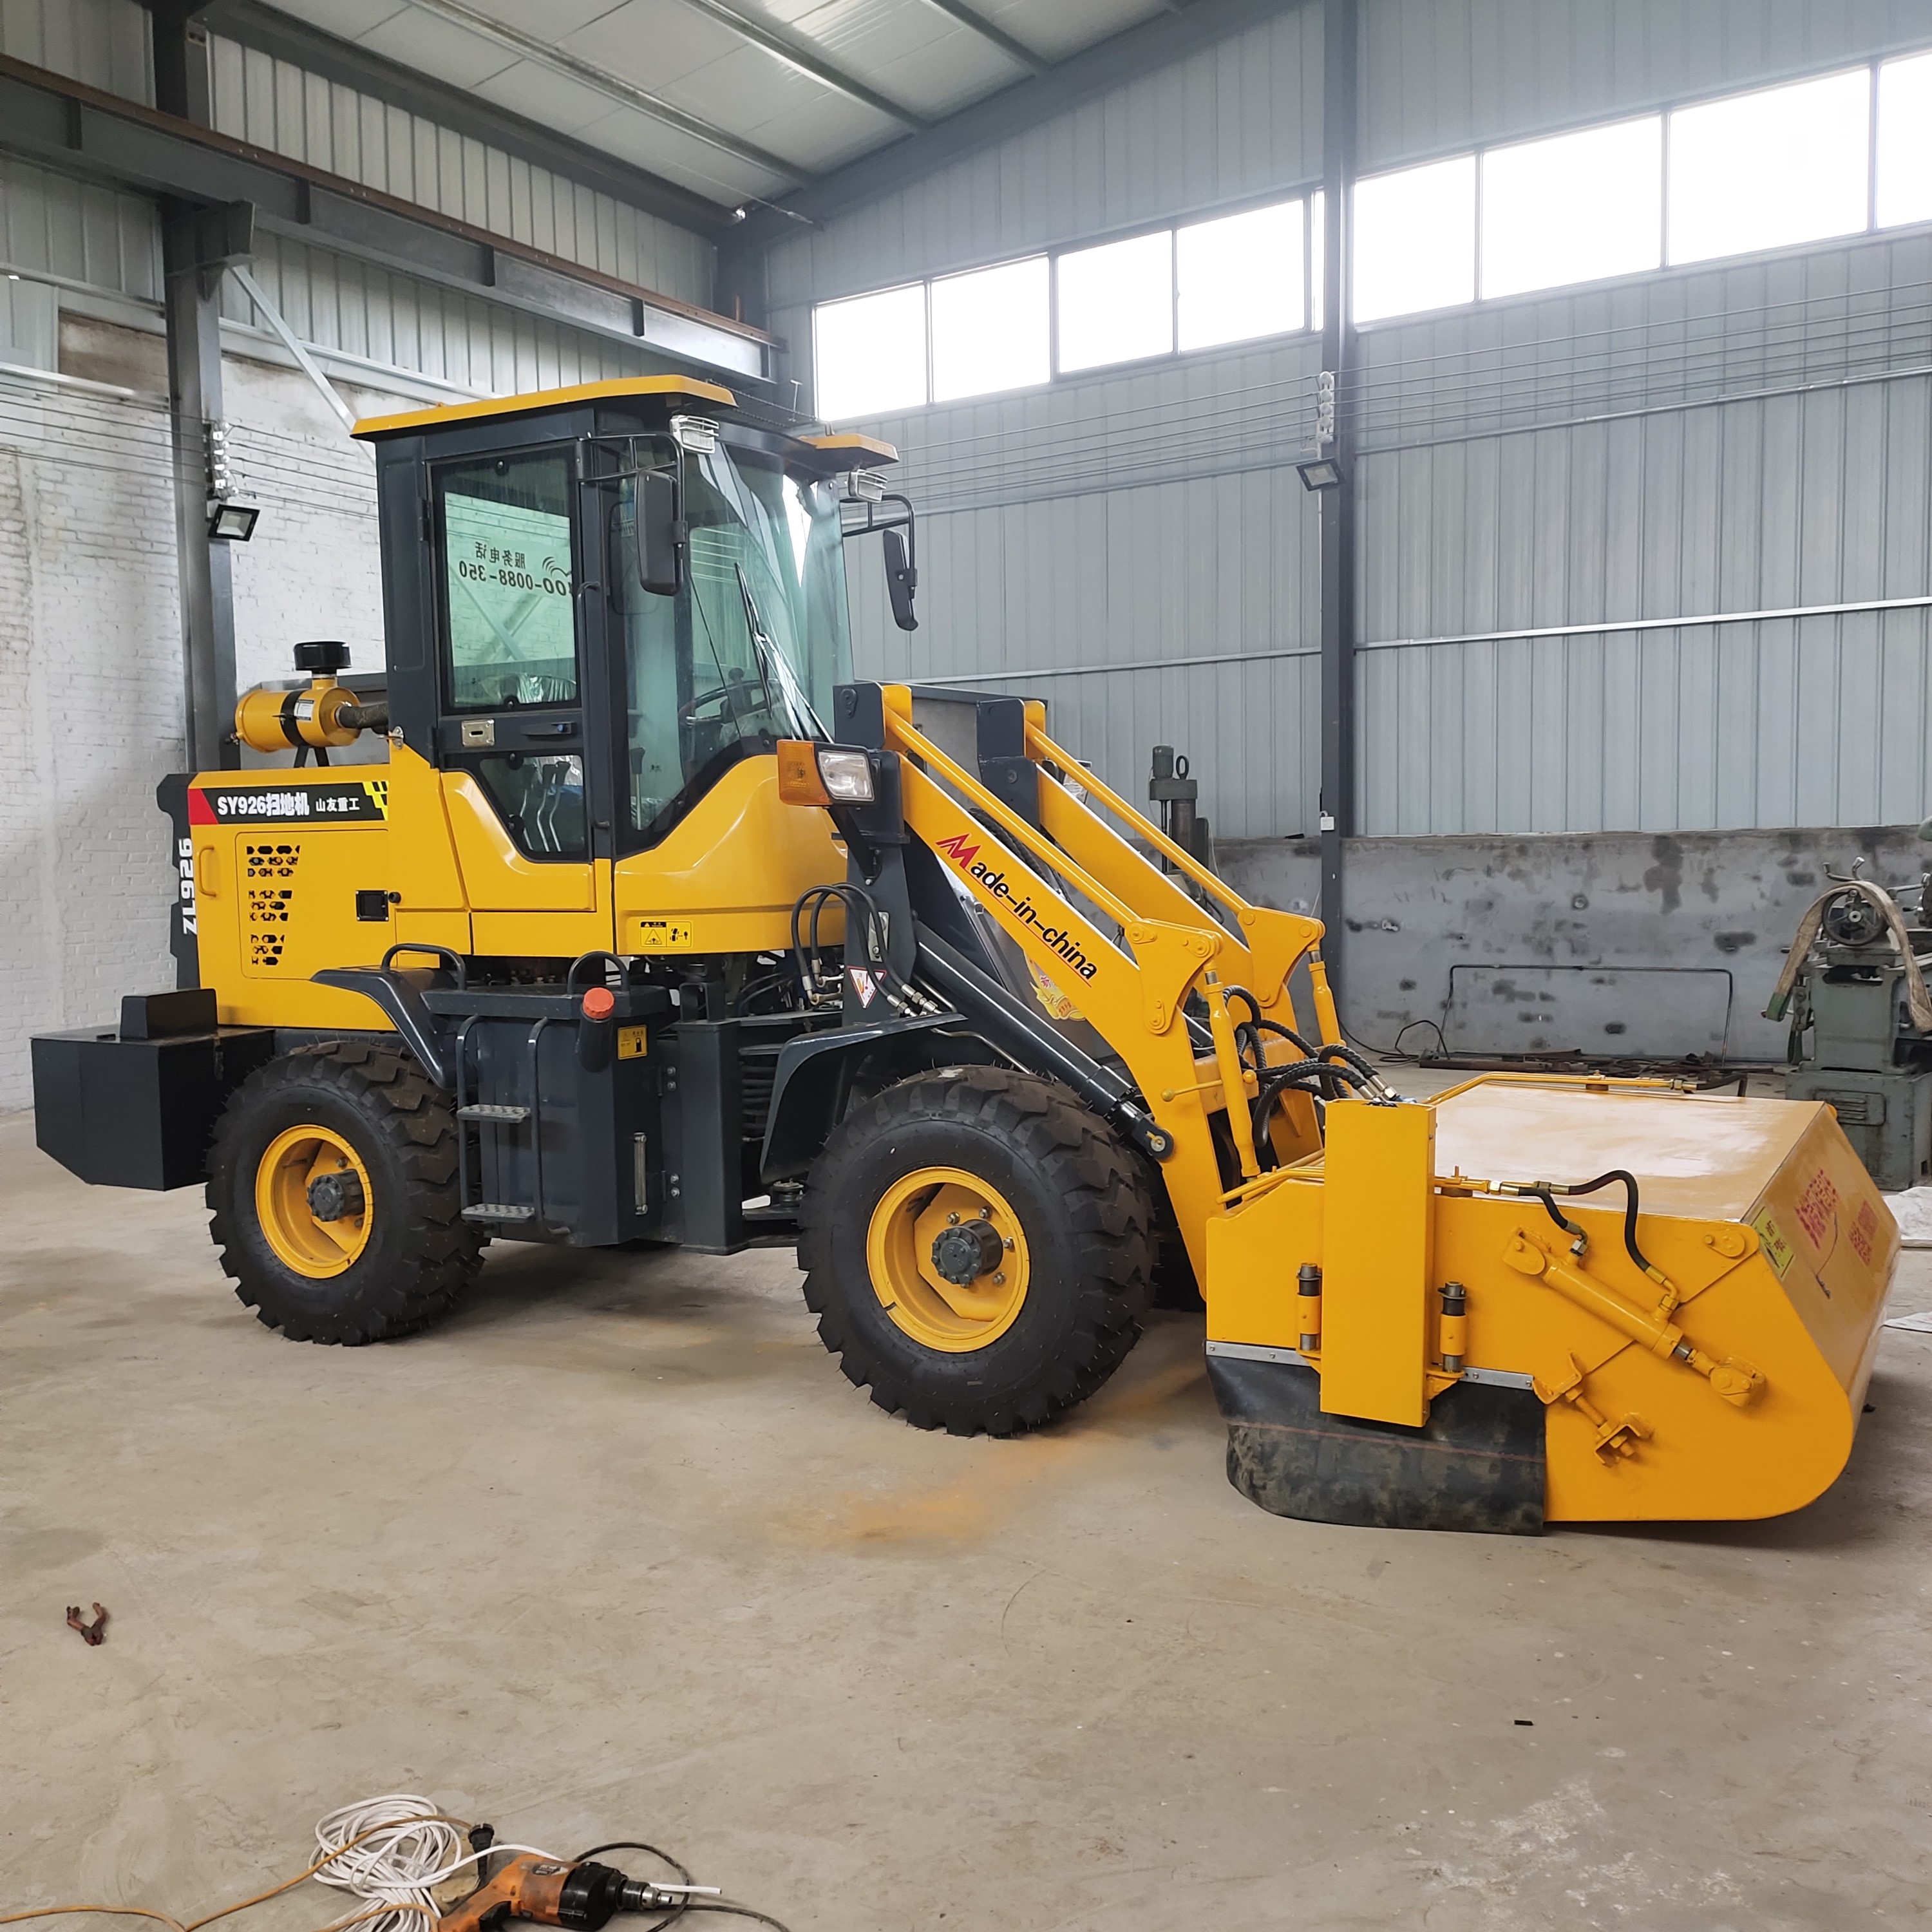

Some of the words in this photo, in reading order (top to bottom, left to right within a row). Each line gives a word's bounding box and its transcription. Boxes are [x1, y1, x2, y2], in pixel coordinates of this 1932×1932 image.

[217, 792, 310, 817] SY926扫地机
[316, 797, 360, 812] 山友重工
[178, 838, 198, 935] ZL926
[935, 833, 1097, 980] Made-in-china
